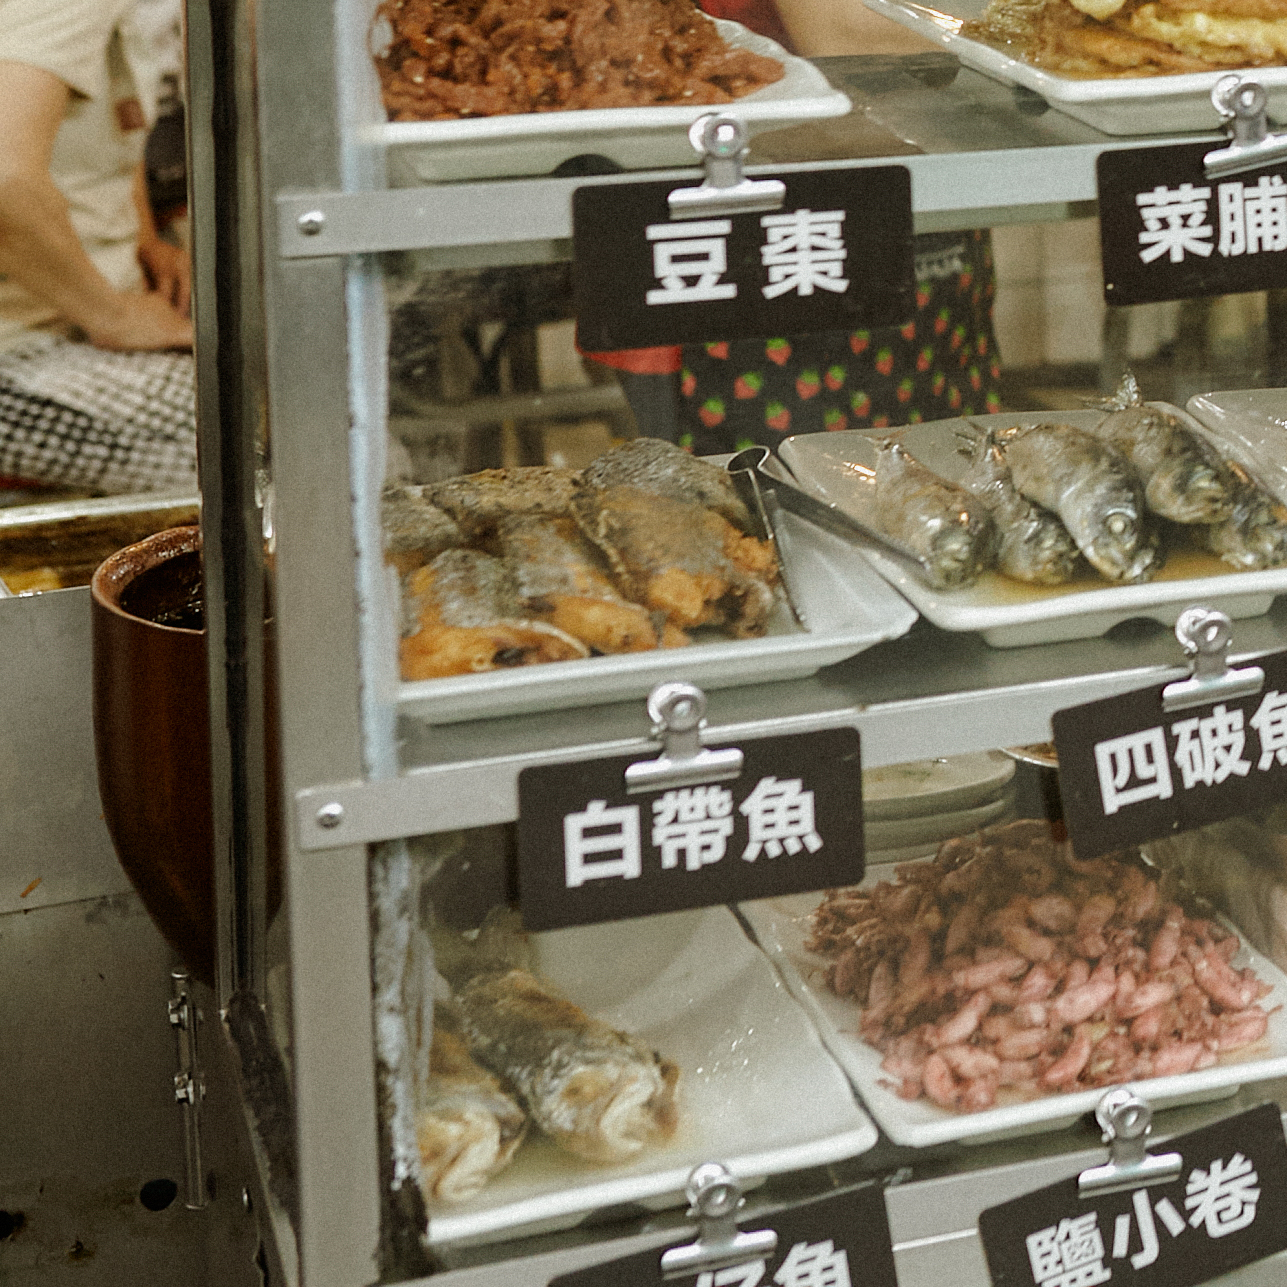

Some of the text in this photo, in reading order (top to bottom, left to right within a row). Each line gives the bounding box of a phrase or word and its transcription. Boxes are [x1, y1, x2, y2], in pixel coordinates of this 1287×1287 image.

[646, 209, 849, 305] 豆棗
[563, 775, 822, 889] 白帶魚
[1026, 1152, 1260, 1287] 鹽小卷
